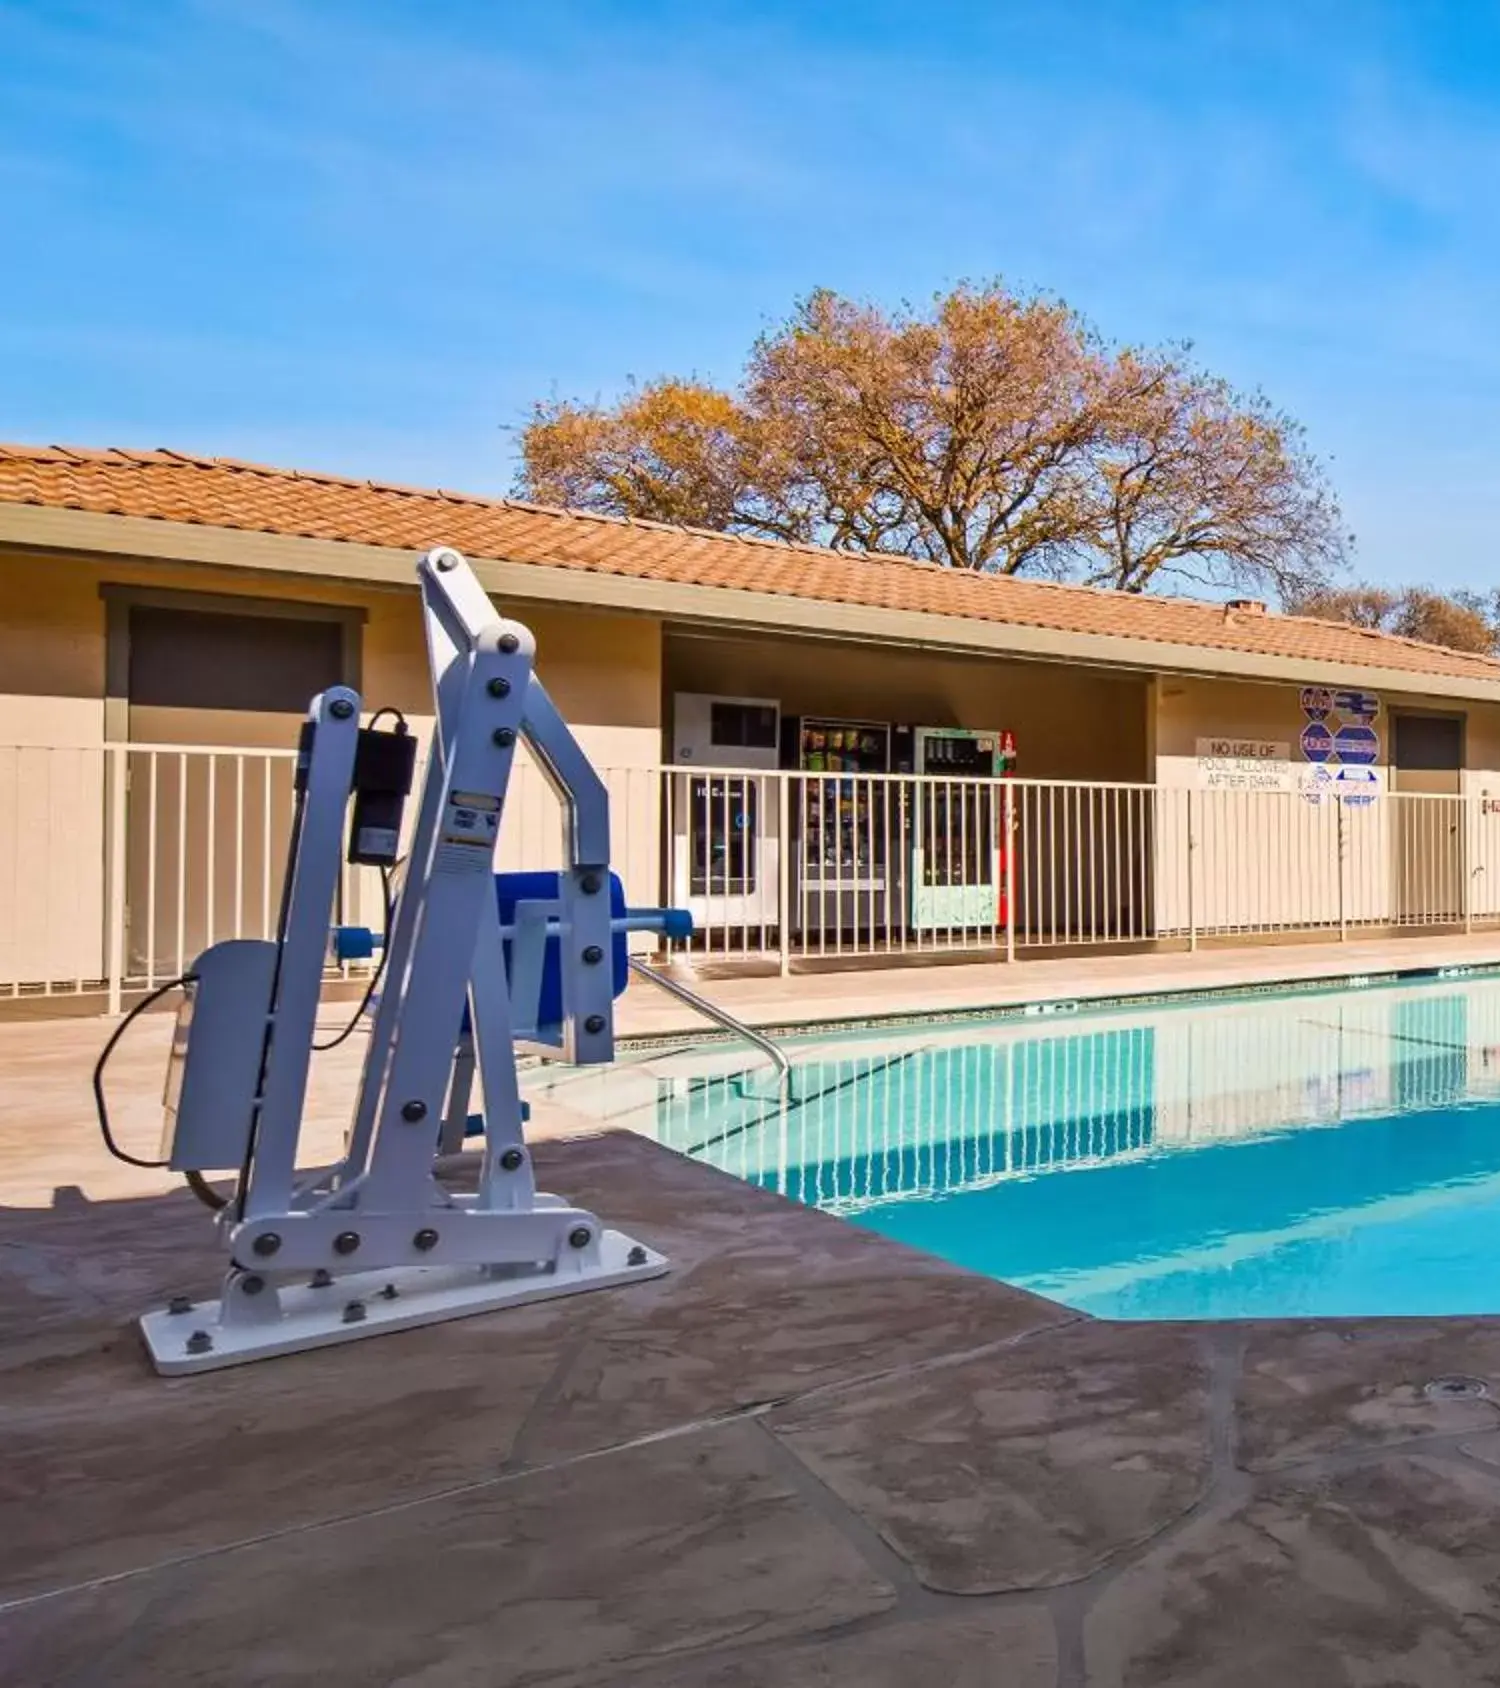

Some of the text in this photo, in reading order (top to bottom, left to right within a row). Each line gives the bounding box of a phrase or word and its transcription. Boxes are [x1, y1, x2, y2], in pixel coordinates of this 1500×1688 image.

[1211, 741, 1276, 757] NO USE OF
[1198, 757, 1289, 774] POOL ALLOWED
[1207, 773, 1281, 789] AFTER DARK
